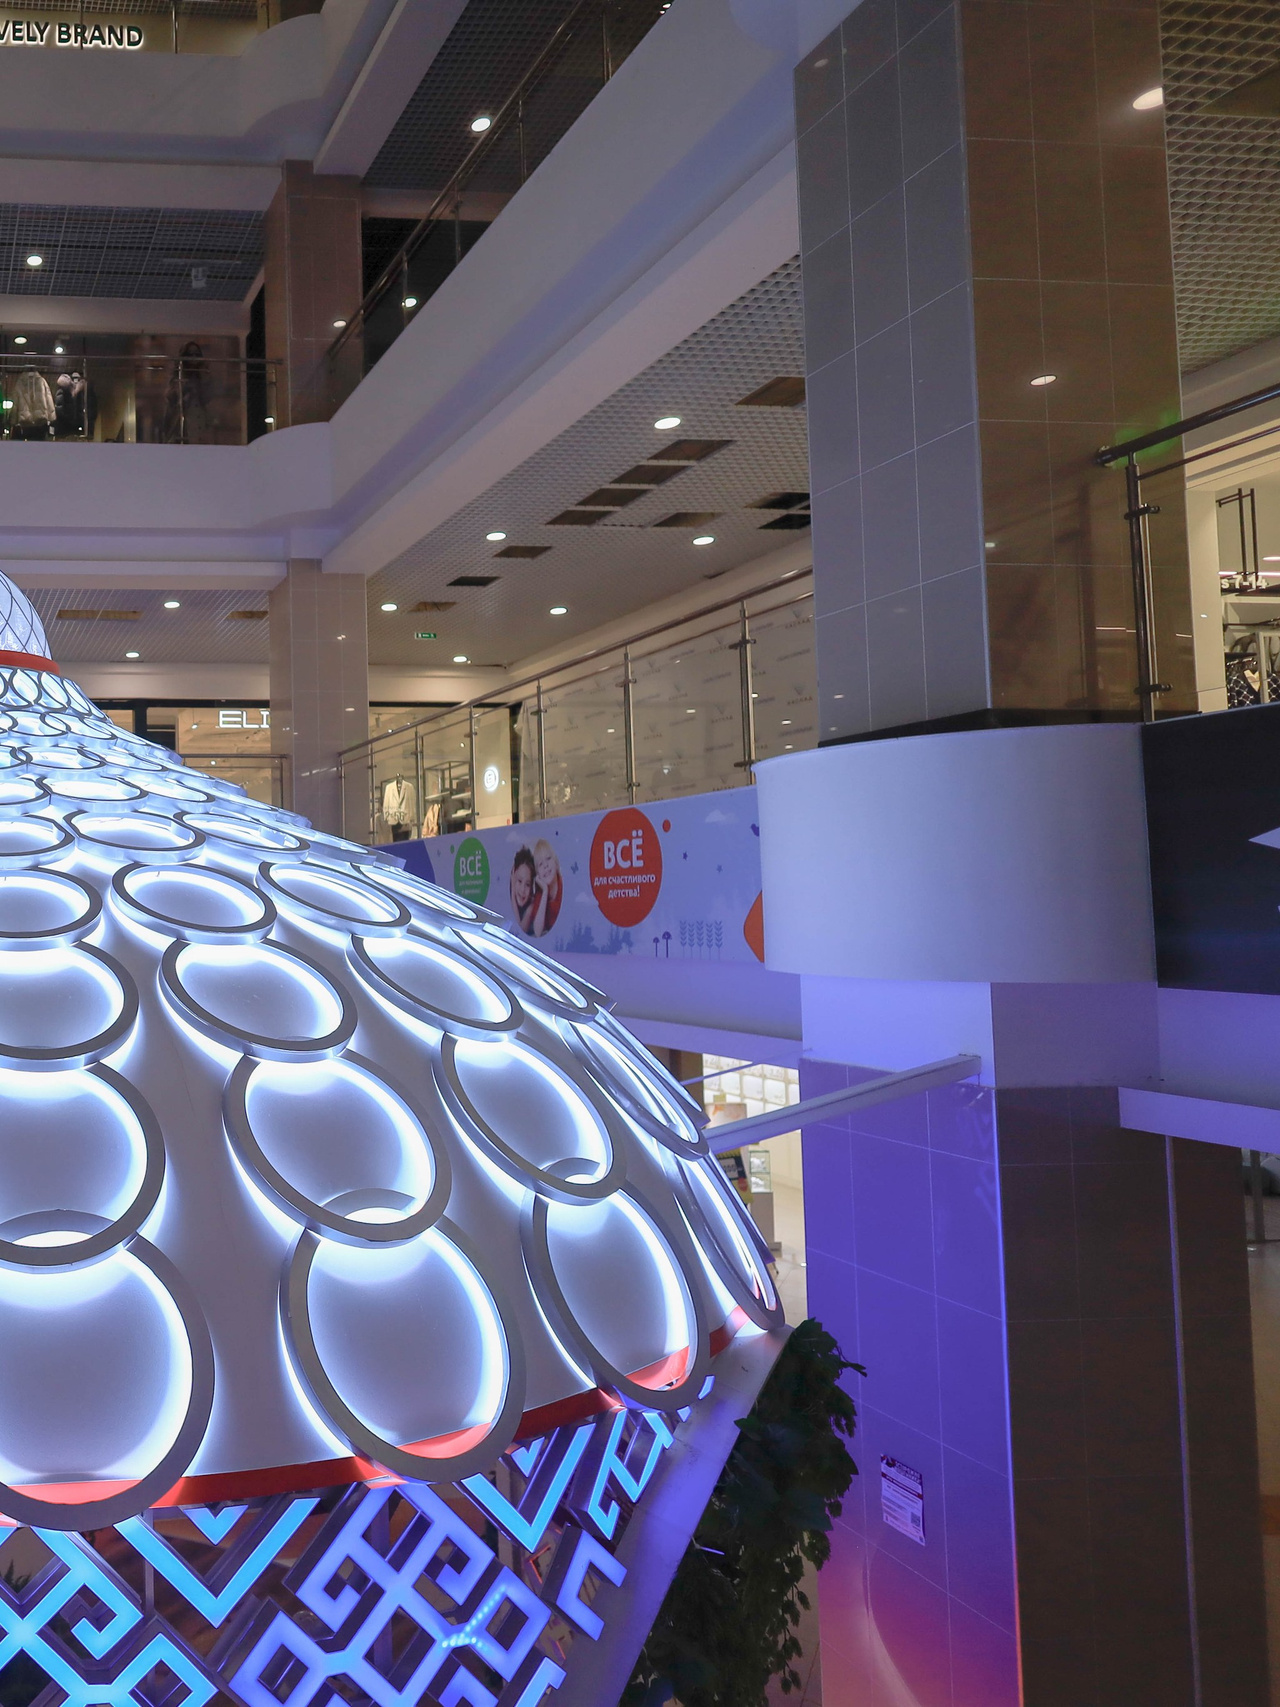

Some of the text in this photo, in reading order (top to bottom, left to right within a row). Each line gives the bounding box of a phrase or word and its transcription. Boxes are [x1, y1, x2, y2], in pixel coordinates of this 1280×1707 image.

[56, 22, 145, 49] BRAND
[604, 829, 644, 869] ВСЁ
[460, 850, 482, 876] ВСЁ
[594, 873, 656, 887] для счастливого
[608, 884, 640, 899] детства!
